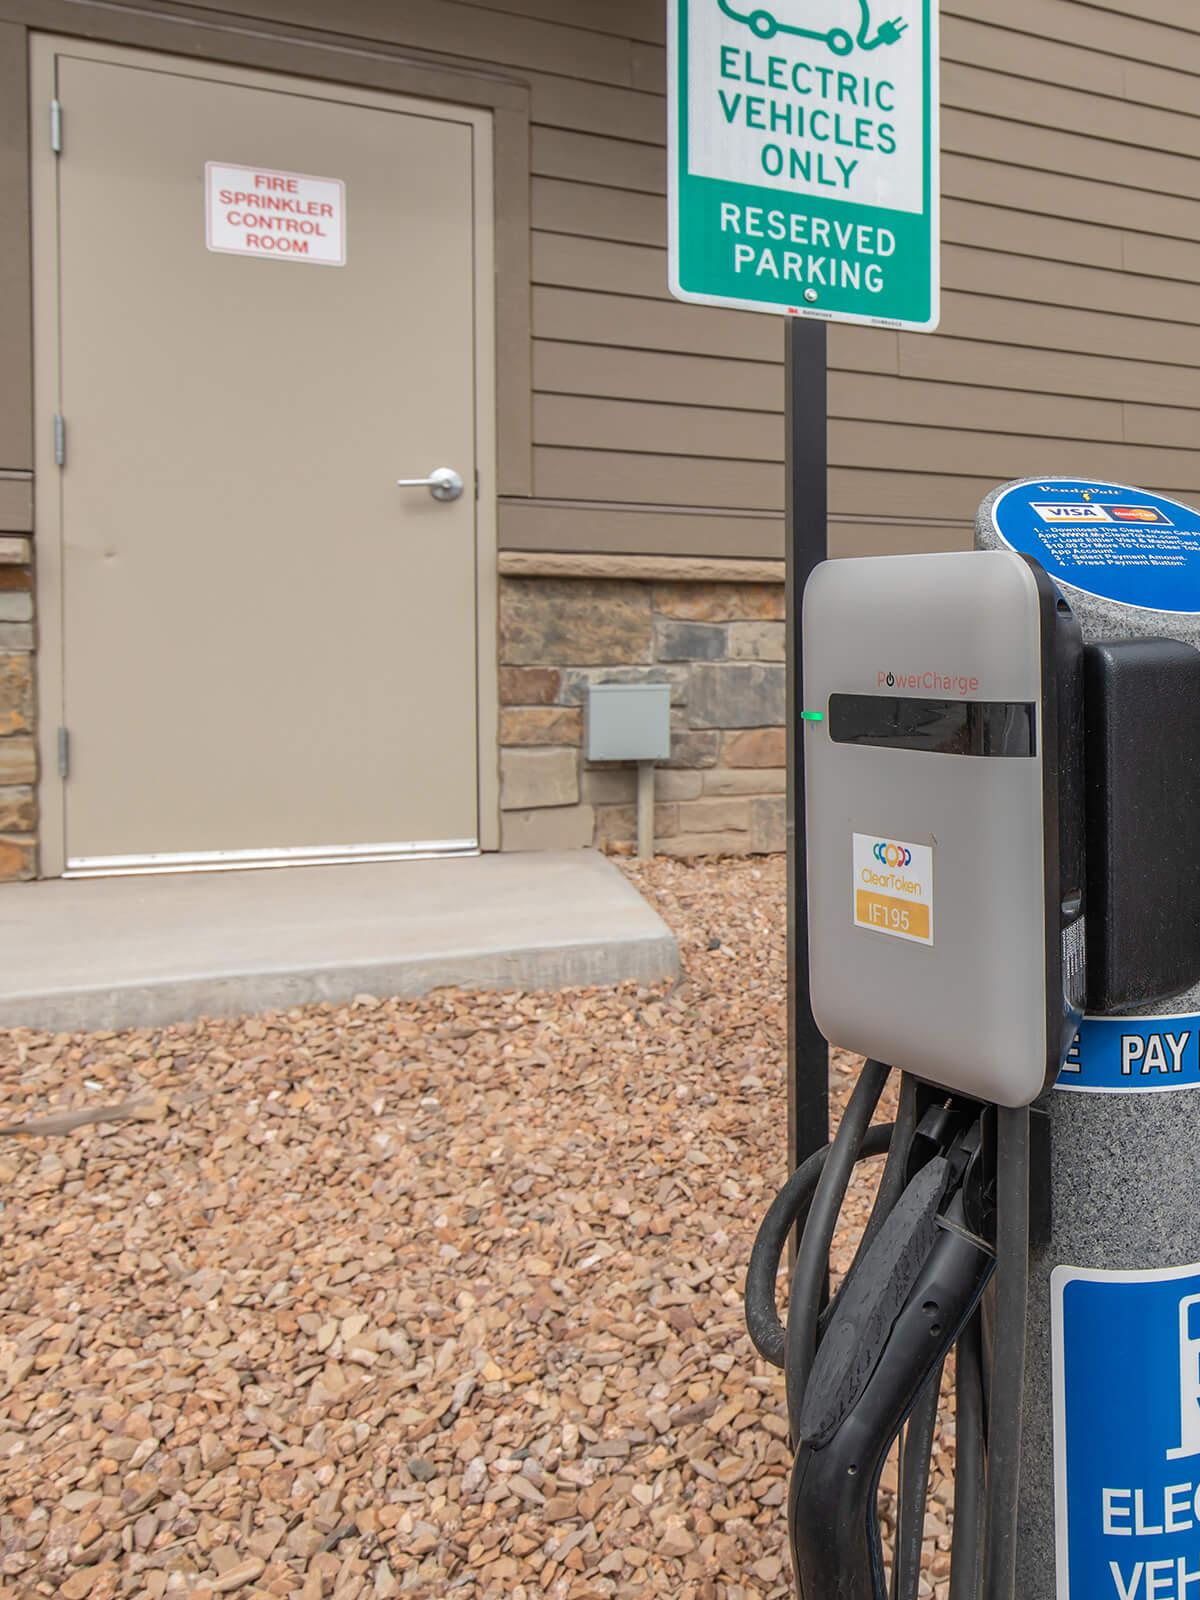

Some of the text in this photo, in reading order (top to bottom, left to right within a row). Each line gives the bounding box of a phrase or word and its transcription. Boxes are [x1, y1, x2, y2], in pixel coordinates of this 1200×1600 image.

[720, 45, 895, 112] ELECTRIC
[718, 89, 897, 154] VEHICLES
[761, 143, 859, 189] ONLY
[254, 174, 299, 194] FIRE
[218, 189, 334, 218] SPRINKLER
[226, 210, 327, 237] CONTROL
[720, 202, 896, 257] RESERVED
[245, 233, 309, 254] ROOM
[734, 243, 884, 293] PARKING
[1047, 508, 1097, 517] VISA
[877, 671, 979, 696] PowerCharge
[861, 868, 922, 897] ClearToken
[868, 903, 910, 930] IF195
[1120, 1031, 1191, 1075] PAY
